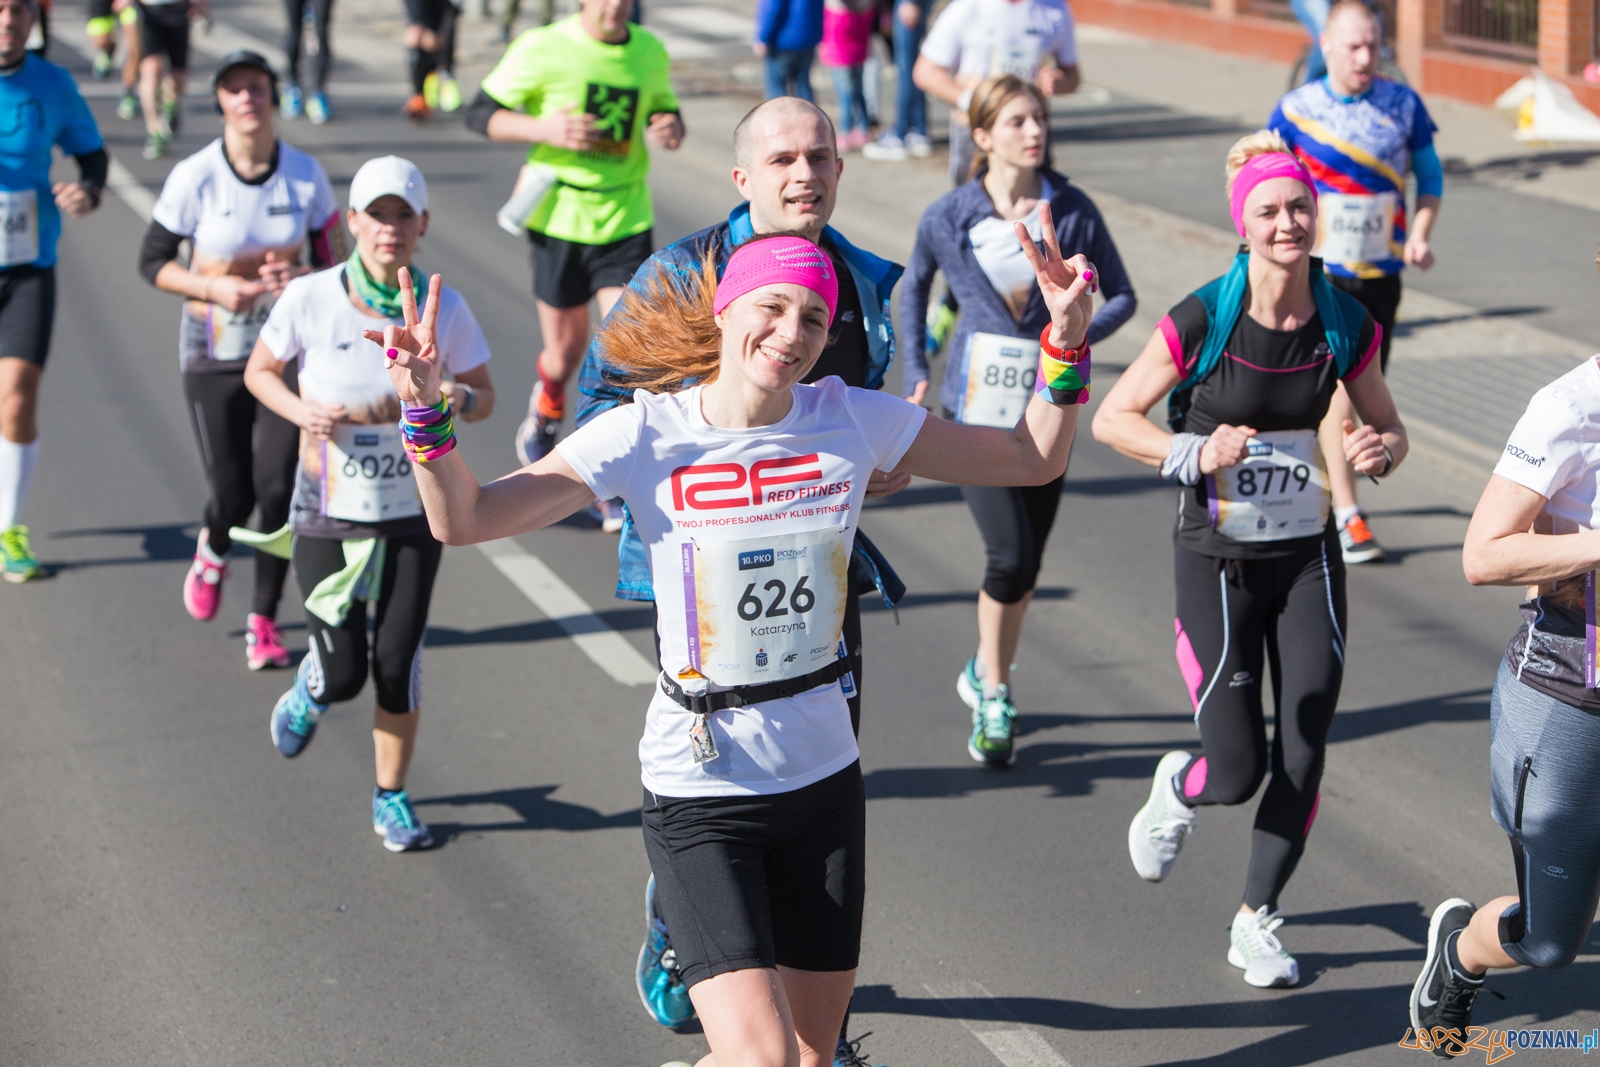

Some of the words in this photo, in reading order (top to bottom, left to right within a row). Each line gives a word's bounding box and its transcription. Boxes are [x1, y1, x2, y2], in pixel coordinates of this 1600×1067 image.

[343, 453, 411, 479] 6026
[767, 489, 795, 503] RED
[799, 480, 850, 499] FITNESS
[1237, 464, 1310, 497] 8779
[676, 519, 702, 528] TWÓJ
[706, 511, 787, 527] PROFESJONALNY
[790, 508, 814, 518] KLUB
[816, 503, 850, 515] FITNESS
[742, 556, 753, 565] 10.
[754, 554, 771, 564] PKO
[737, 575, 815, 621] 626
[750, 621, 806, 637] Katarzyna
[784, 653, 798, 663] 4F
